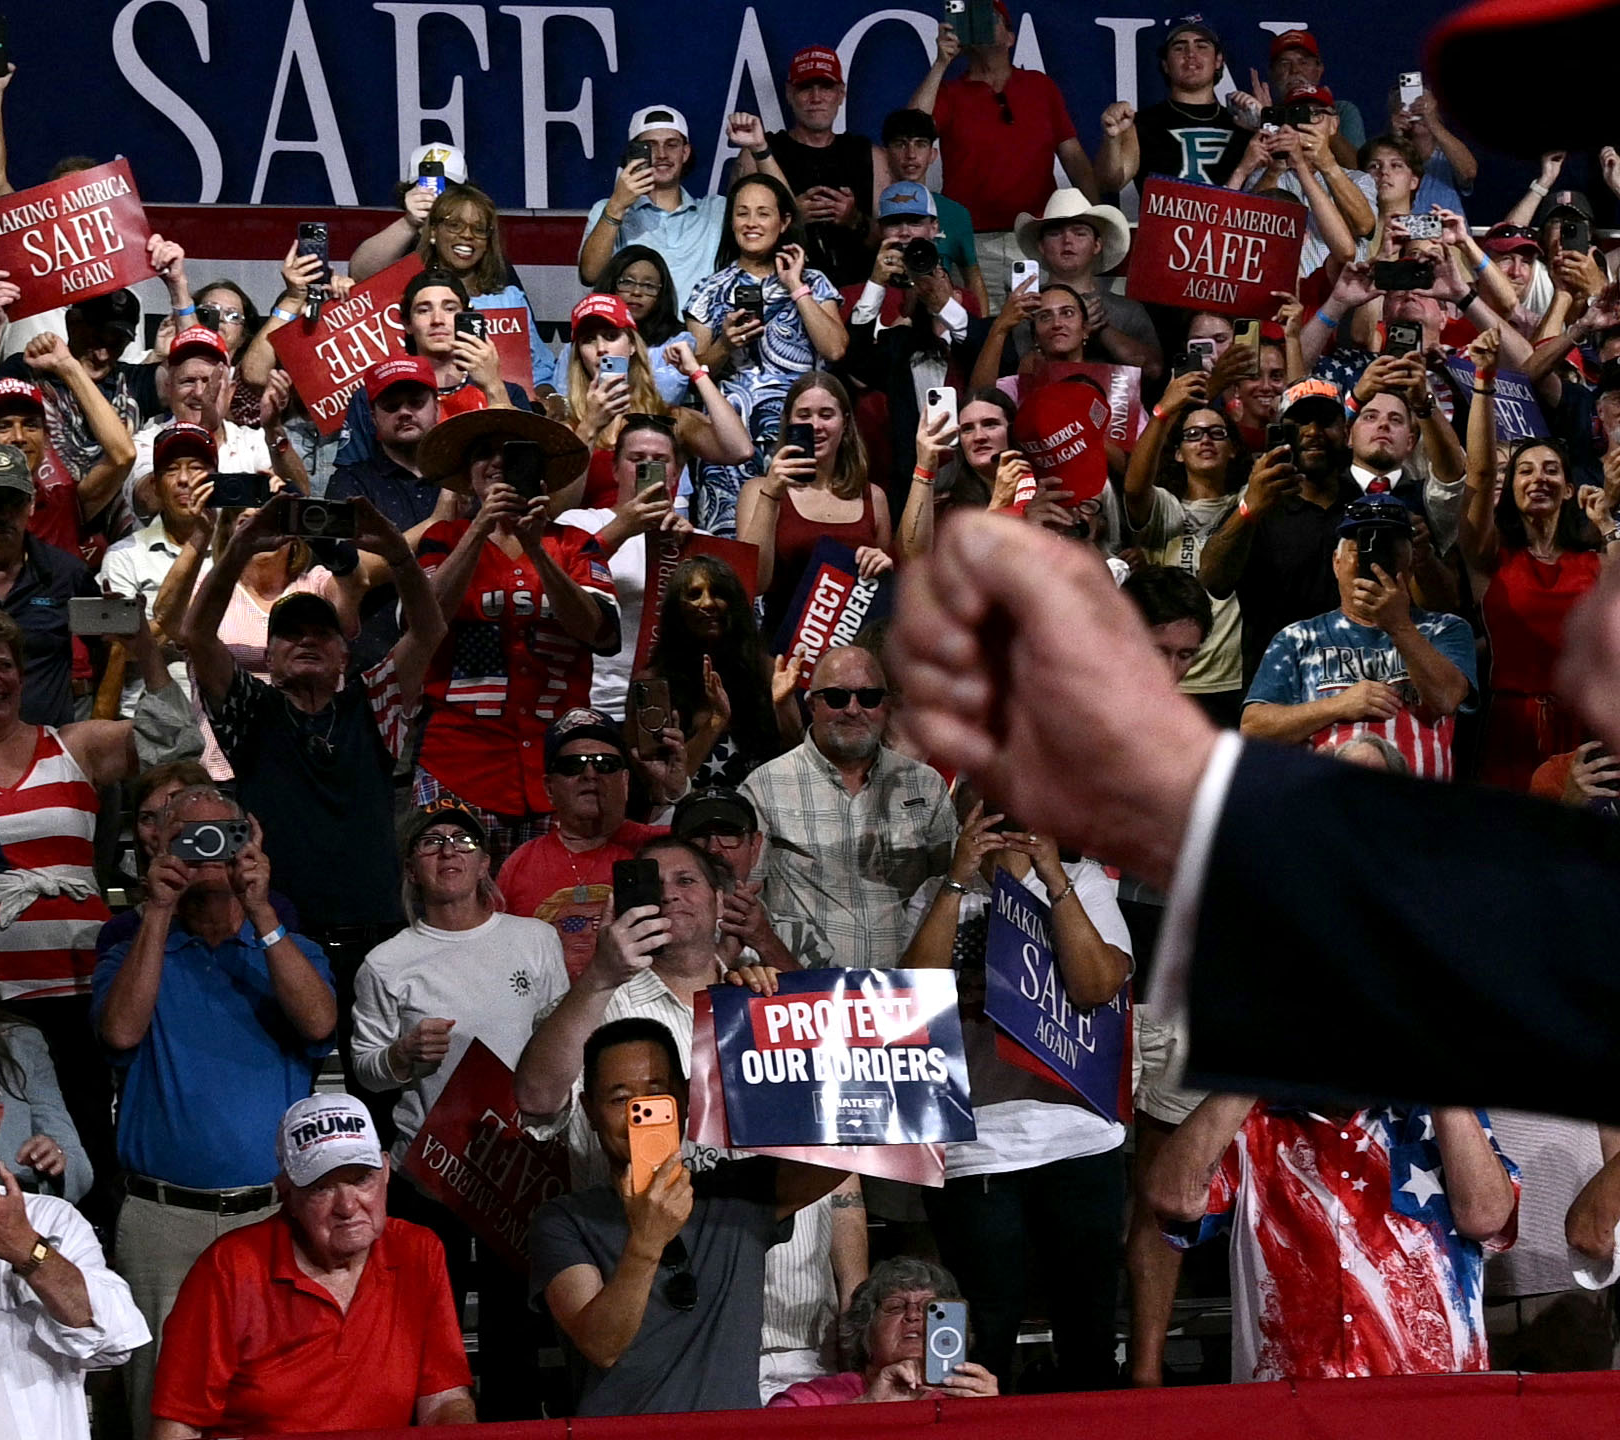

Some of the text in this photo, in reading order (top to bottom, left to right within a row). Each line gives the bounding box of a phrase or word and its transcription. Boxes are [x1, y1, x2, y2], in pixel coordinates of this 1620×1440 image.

[61, 174, 132, 216] AMERICA
[1146, 194, 1298, 239] MAKING AMERICA
[21, 206, 125, 277] SAFE
[1168, 224, 1268, 285] SAFE
[61, 260, 116, 295] AGAIN
[1183, 280, 1239, 305] AGAIN
[324, 290, 373, 334] AGAIN
[485, 317, 523, 335] RICA
[312, 377, 368, 421] RICA
[1111, 373, 1129, 441] MAKING
[1057, 439, 1089, 465] AGAIN
[827, 574, 880, 649] ORDERS
[1316, 646, 1405, 684] TRUM
[997, 888, 1055, 949] MAKIN
[764, 999, 913, 1043] PROTECT
[1035, 1005, 1078, 1070] AGAIN
[741, 1048, 948, 1085] OUR BORDERS
[291, 1117, 367, 1147] TRUMP
[422, 1133, 504, 1216] AMERICA
